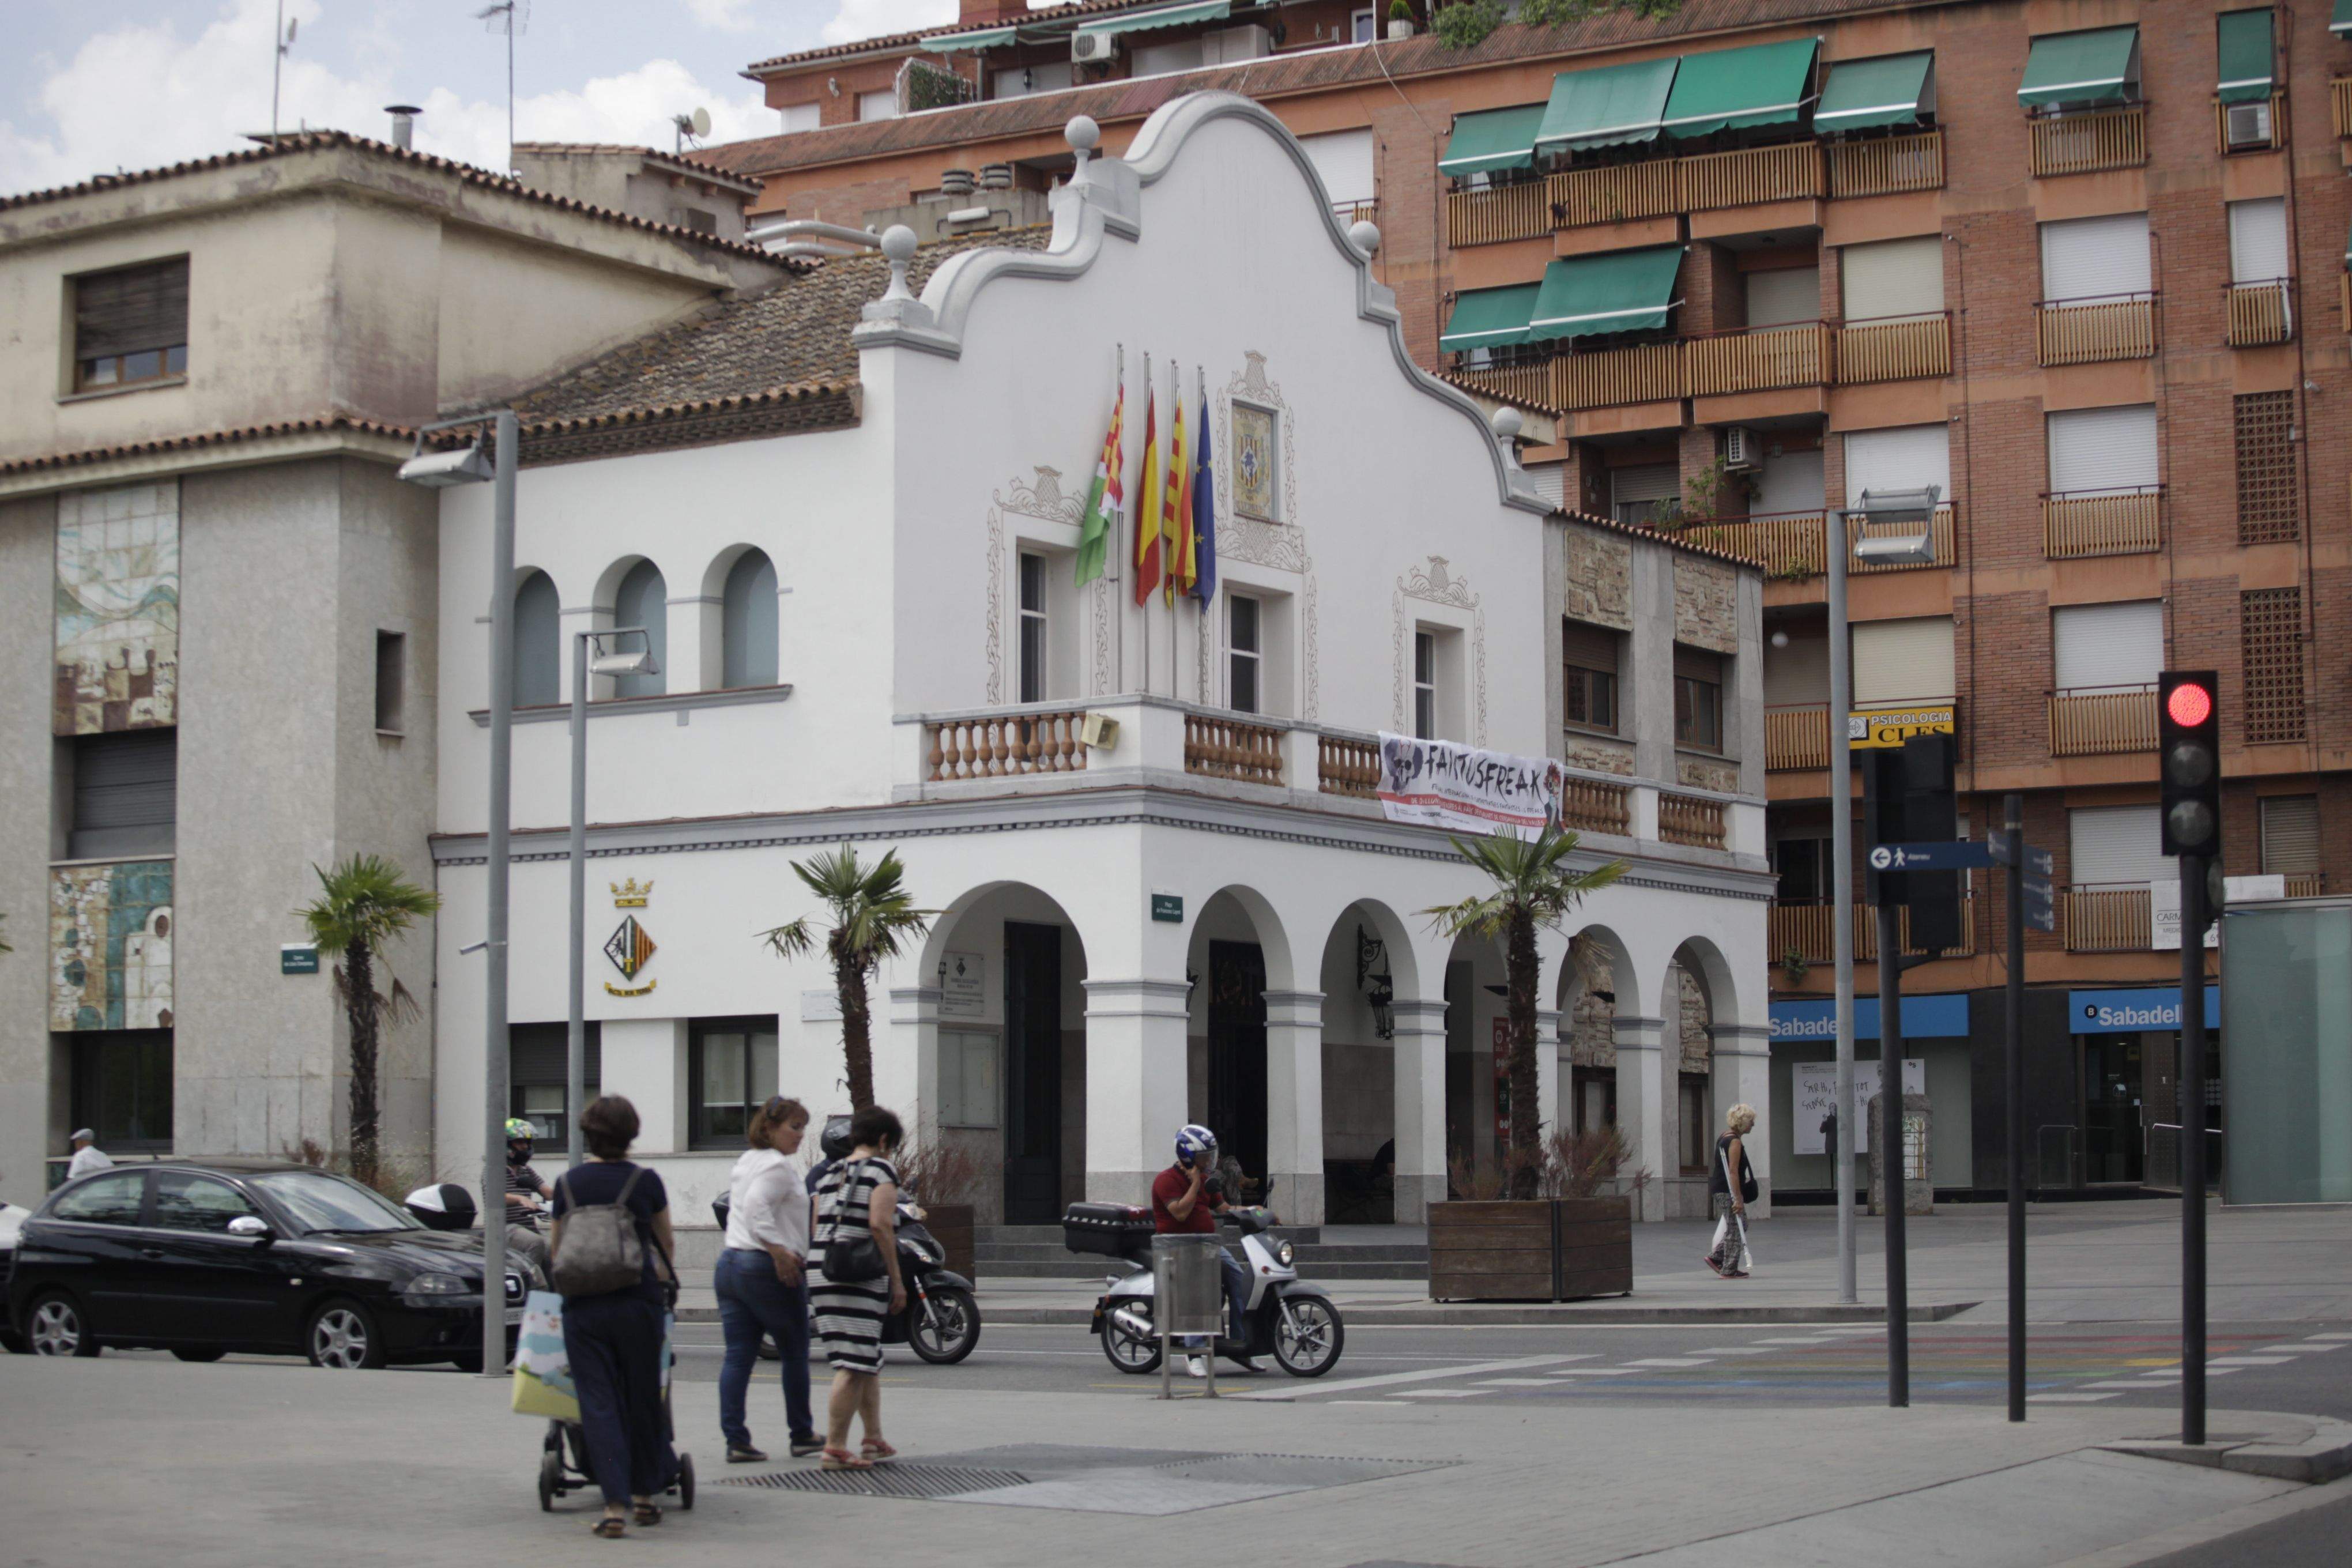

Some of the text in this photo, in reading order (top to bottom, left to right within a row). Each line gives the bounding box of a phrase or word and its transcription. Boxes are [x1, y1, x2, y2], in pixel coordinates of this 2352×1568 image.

[1871, 711, 1952, 726] PSICOLOGIA
[2157, 913, 2181, 922] CARM
[1770, 1016, 1837, 1036] Sabade
